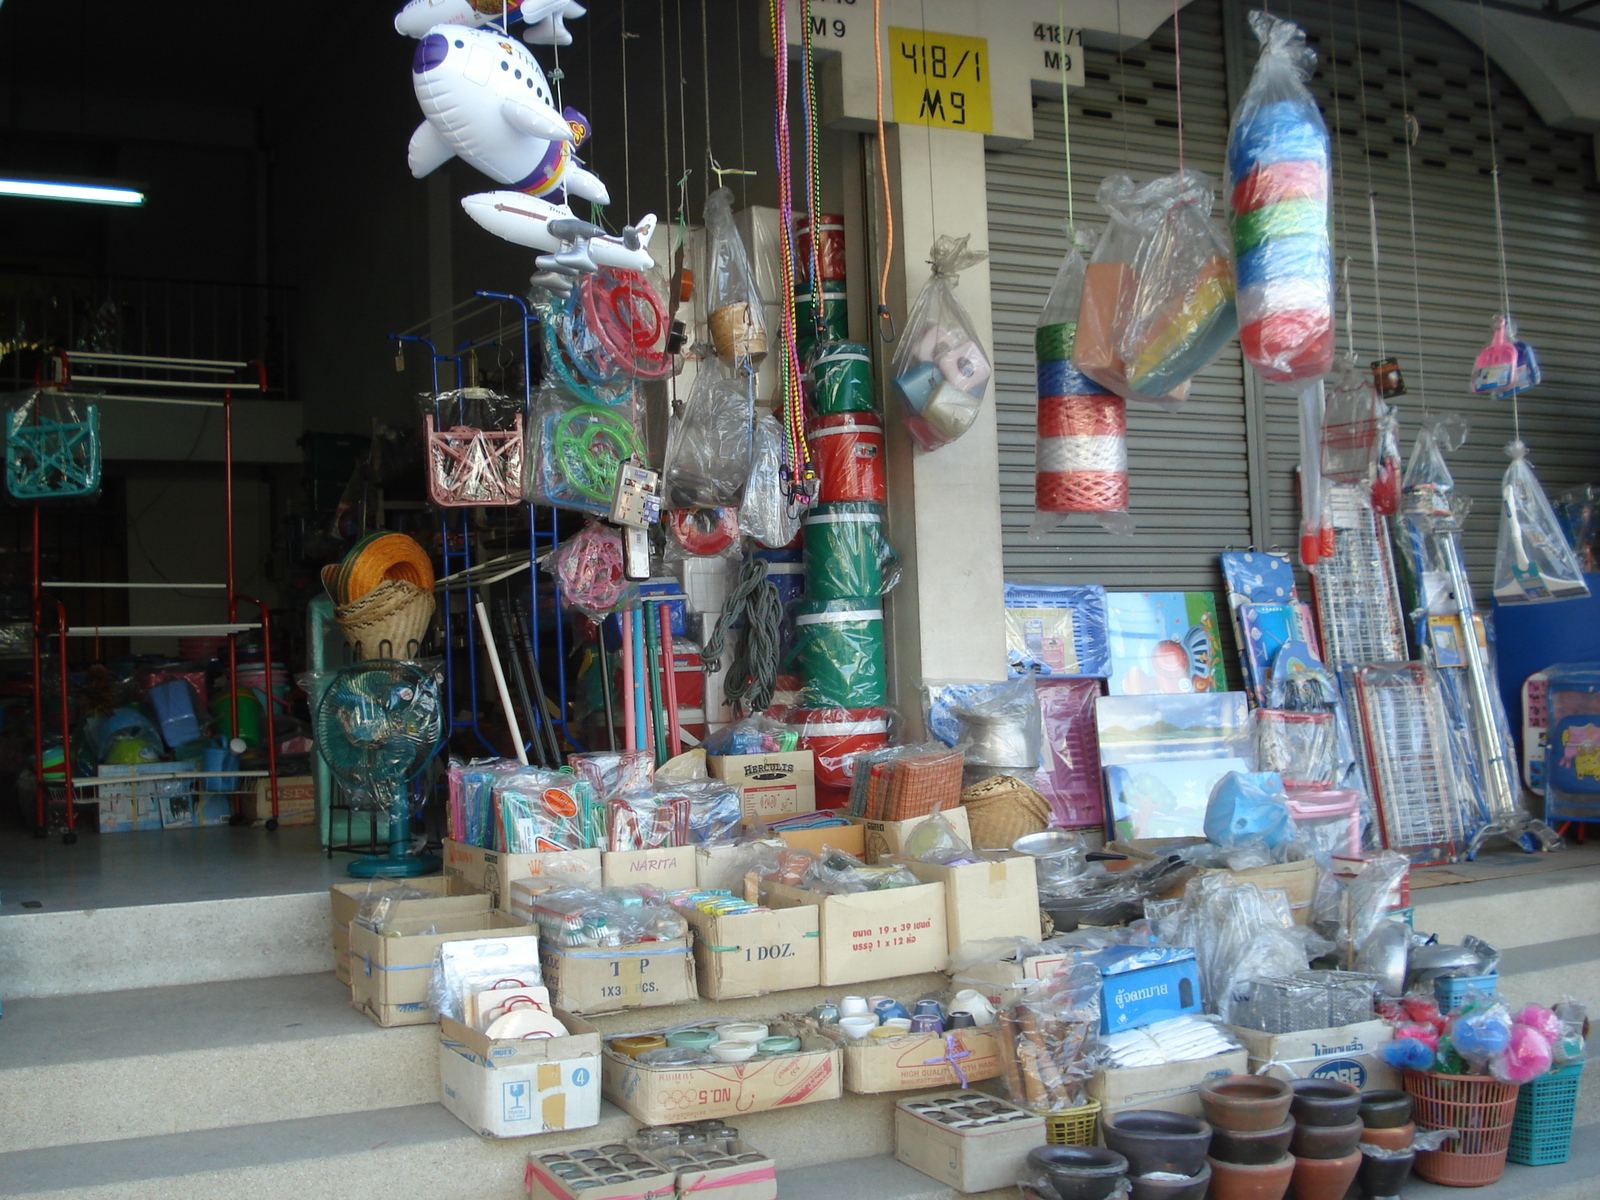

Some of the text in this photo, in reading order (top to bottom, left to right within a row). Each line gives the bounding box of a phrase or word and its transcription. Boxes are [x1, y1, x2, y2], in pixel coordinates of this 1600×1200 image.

[1034, 24, 1083, 47] 418/1
[901, 41, 981, 82] 418/1
[629, 857, 677, 873] NARITA
[879, 926, 889, 935] 19
[900, 923, 911, 932] 39
[893, 937, 903, 946] 12
[745, 943, 796, 962] 1 DOZ.
[610, 958, 650, 977] TP
[1115, 984, 1168, 1009] ตู้จดหมาย
[576, 1070, 586, 1085] 4
[901, 1070, 920, 1078] HIGH
